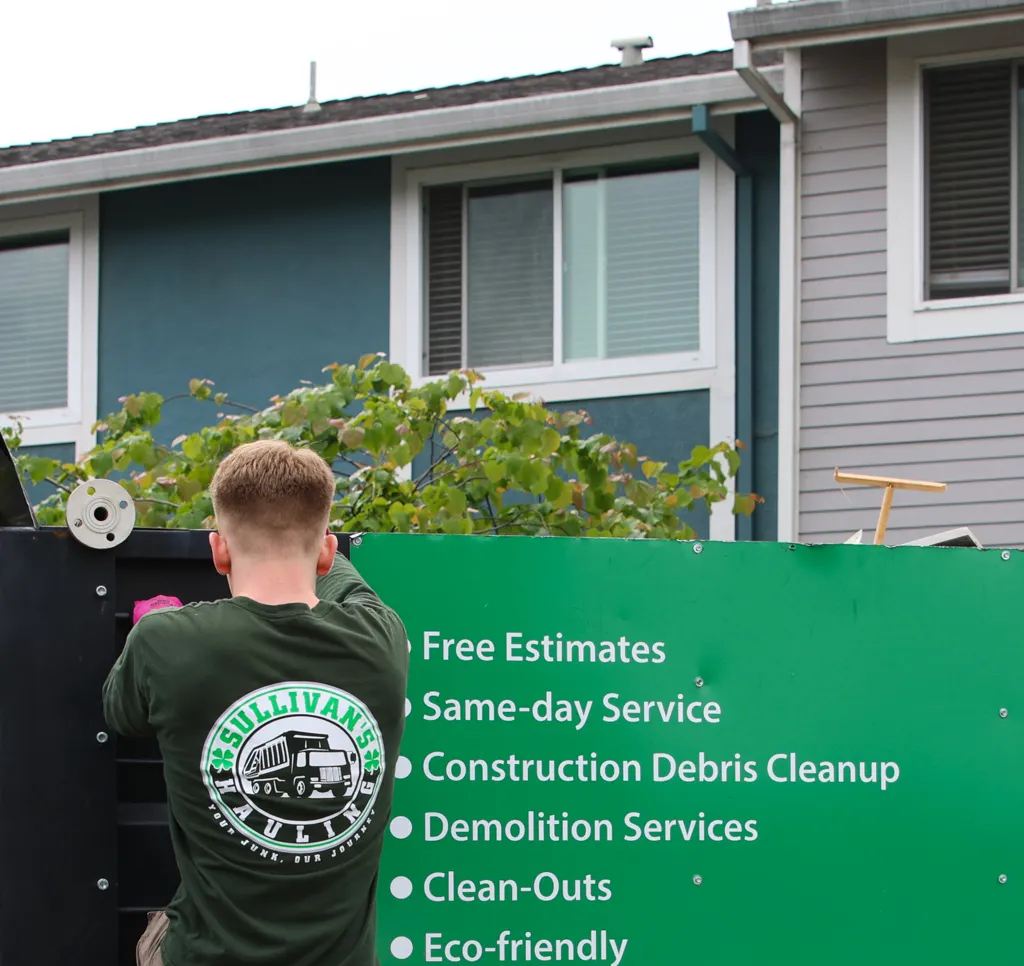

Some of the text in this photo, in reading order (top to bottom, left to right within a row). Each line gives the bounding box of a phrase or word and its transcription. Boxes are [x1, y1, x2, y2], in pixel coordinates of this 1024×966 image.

[424, 632, 666, 663] Free Estimates
[220, 692, 375, 748] SULLIVAN'S
[424, 692, 721, 730] Same-day Service
[424, 752, 899, 790] Construction Debris Cleanup
[215, 779, 374, 843] HAULING
[425, 811, 758, 841] Demolition Services
[208, 804, 235, 835] YOUR
[295, 855, 322, 863] OUR
[331, 809, 375, 857] JOURNEY
[424, 871, 611, 901] Clean-Outs
